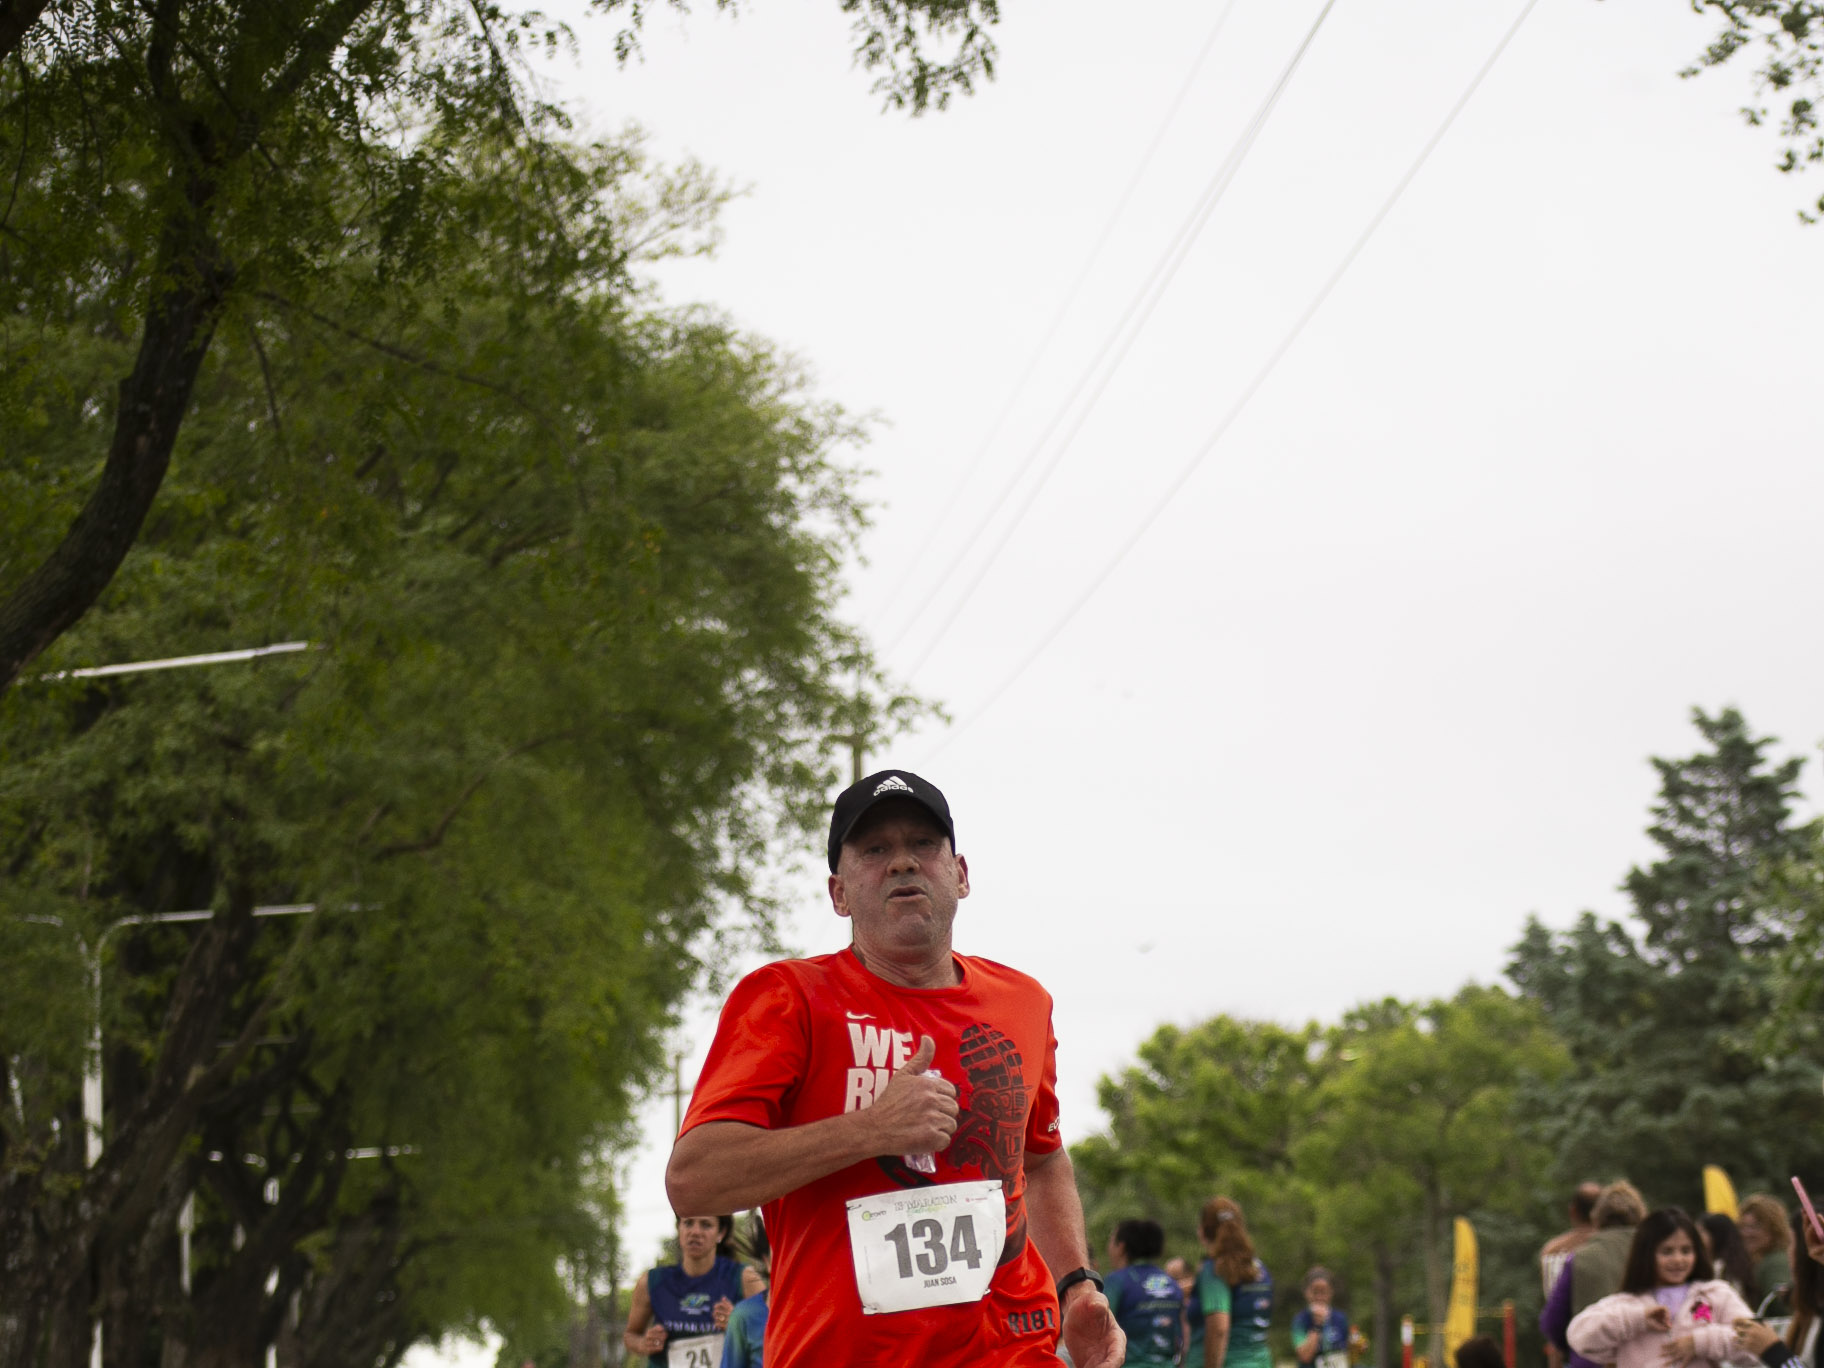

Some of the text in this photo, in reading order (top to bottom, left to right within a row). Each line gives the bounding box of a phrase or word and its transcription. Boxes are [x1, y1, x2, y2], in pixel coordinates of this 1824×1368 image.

[847, 1022, 914, 1071] WE
[884, 1214, 983, 1279] 134
[923, 1276, 957, 1288] JUAN SOSA
